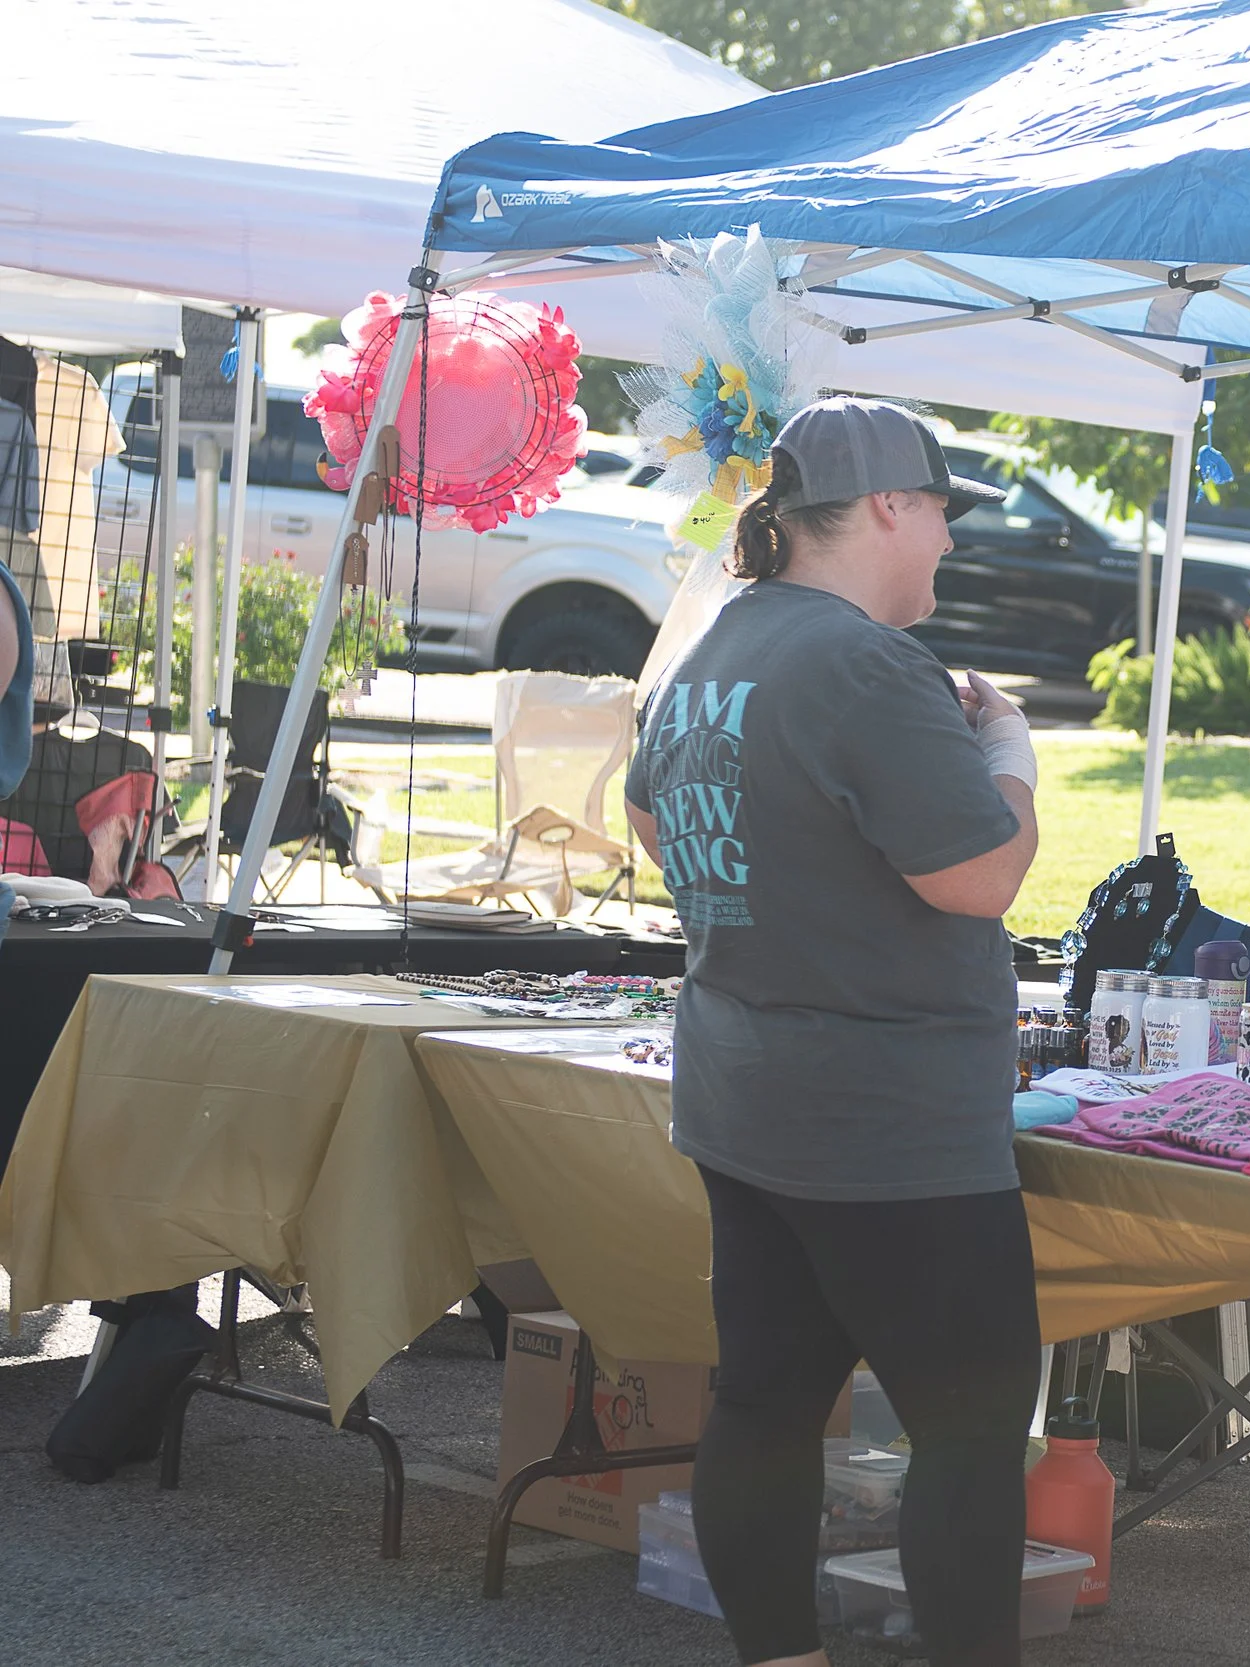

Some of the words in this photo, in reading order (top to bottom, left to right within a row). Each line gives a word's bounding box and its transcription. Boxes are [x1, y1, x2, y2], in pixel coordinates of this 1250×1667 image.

[501, 193, 540, 207] OZARK
[651, 680, 758, 751] AM
[655, 783, 743, 842] NEW
[1166, 1023, 1174, 1031] by
[1149, 1040, 1165, 1048] Loved
[1166, 1042, 1175, 1050] by
[1161, 1061, 1170, 1069] by
[516, 1332, 557, 1355] SMALL
